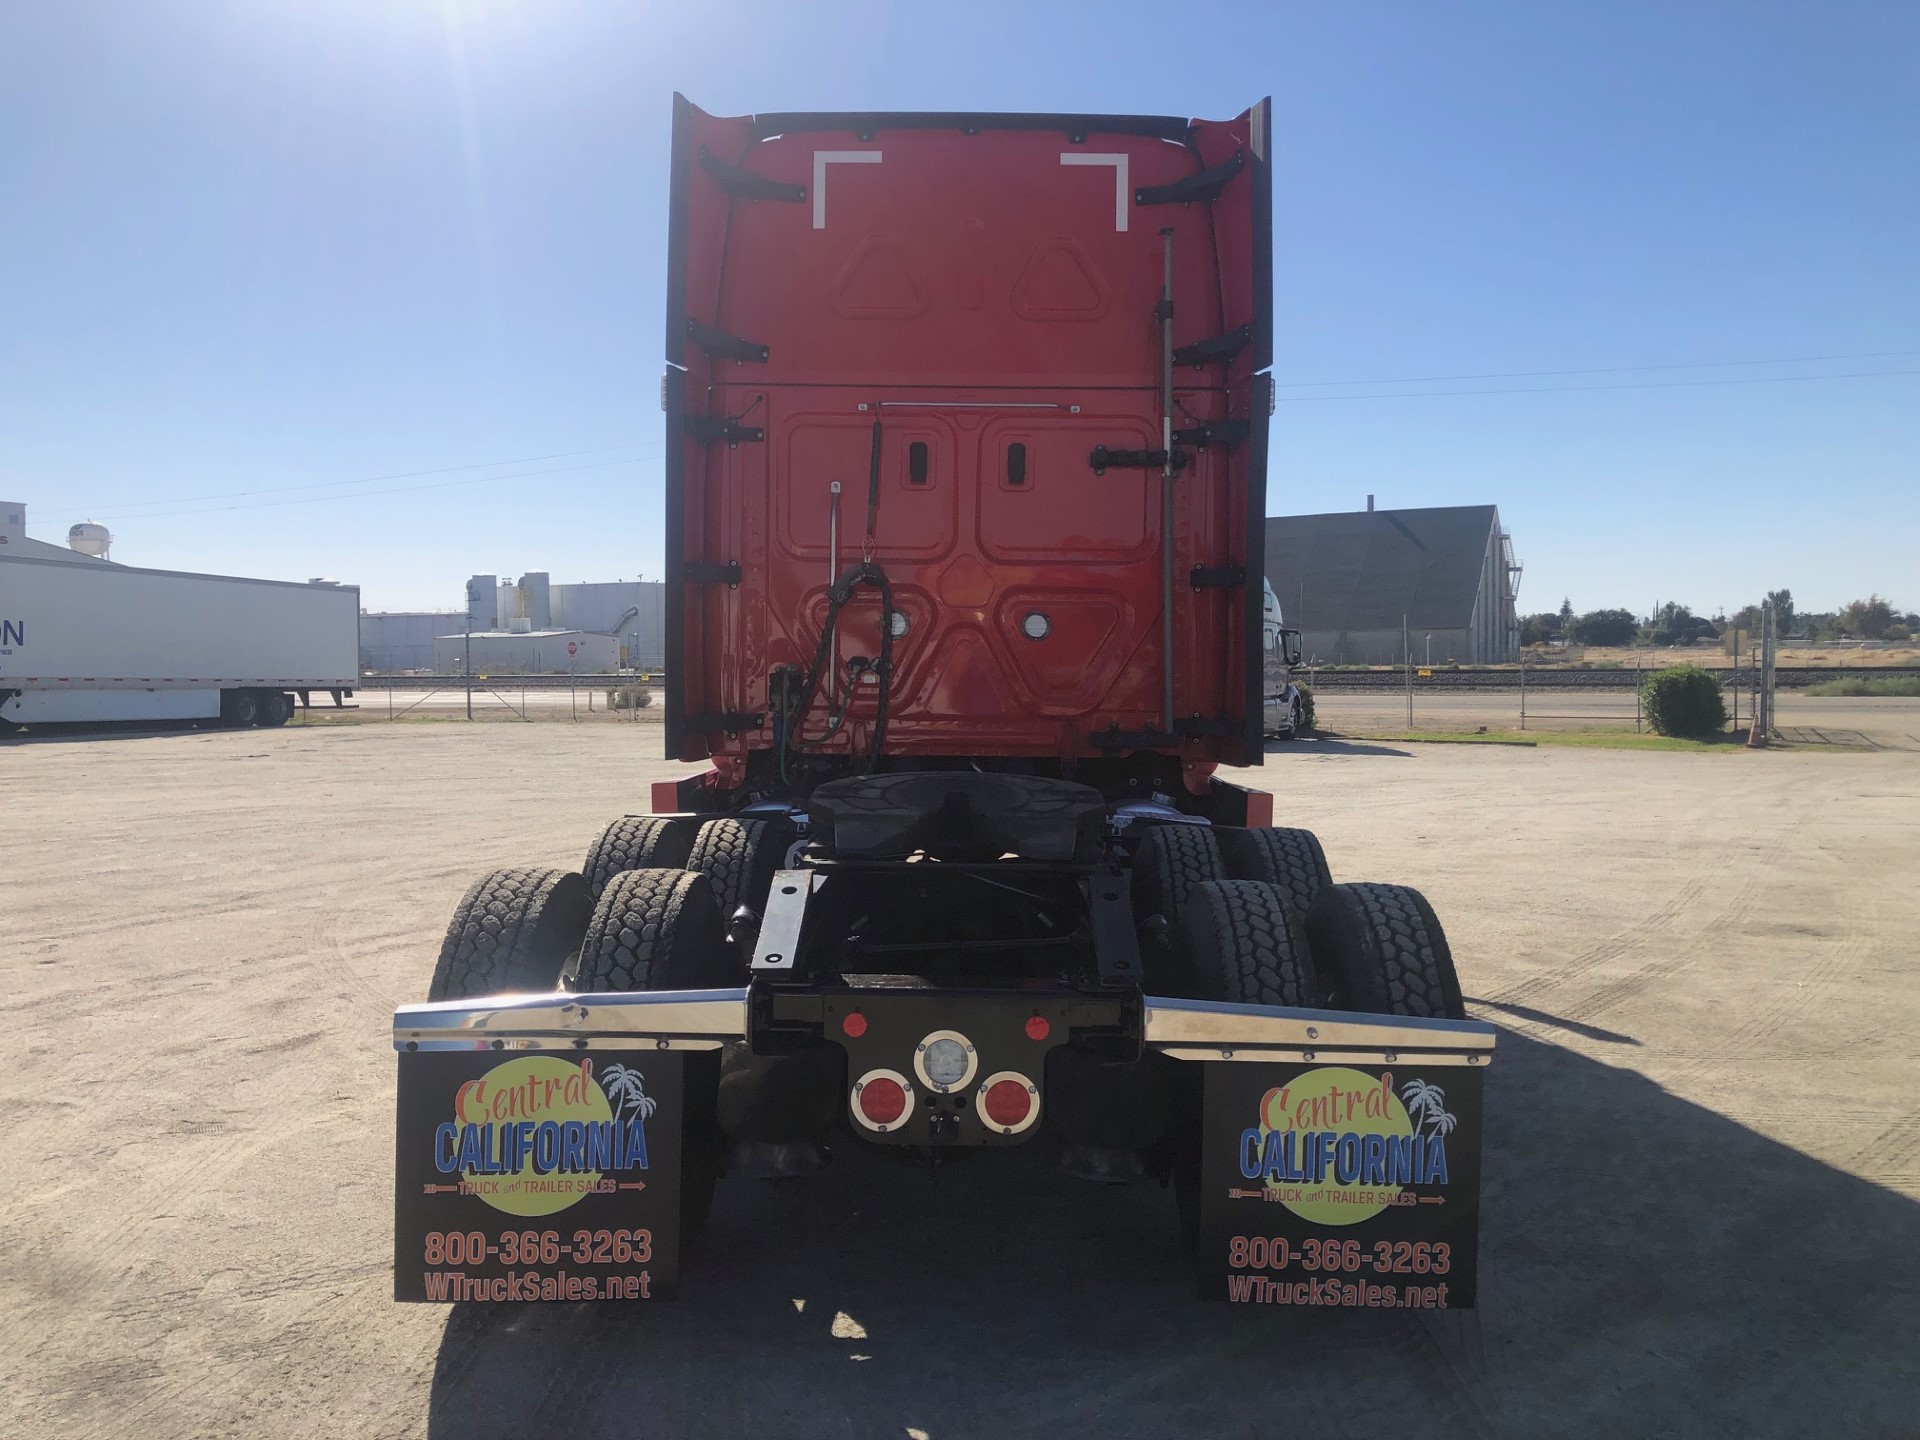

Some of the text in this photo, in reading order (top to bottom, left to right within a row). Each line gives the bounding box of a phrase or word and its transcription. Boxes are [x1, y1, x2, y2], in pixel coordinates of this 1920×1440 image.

[0, 619, 23, 646] N
[455, 1058, 593, 1126] Central
[1260, 1072, 1393, 1133] Central
[435, 1120, 648, 1174] CALIFORNIA
[1240, 1128, 1448, 1185] CALIFORNIA
[458, 1179, 616, 1195] TRUCK and TRAILER SALES
[1262, 1187, 1417, 1206] TRUCK and TRAILER SALES
[424, 1229, 651, 1265] 800-366-3263
[1229, 1235, 1450, 1274] 800-366-3263
[424, 1270, 650, 1301] WTruckSales.net
[1228, 1275, 1449, 1309] WTruckSales.net
